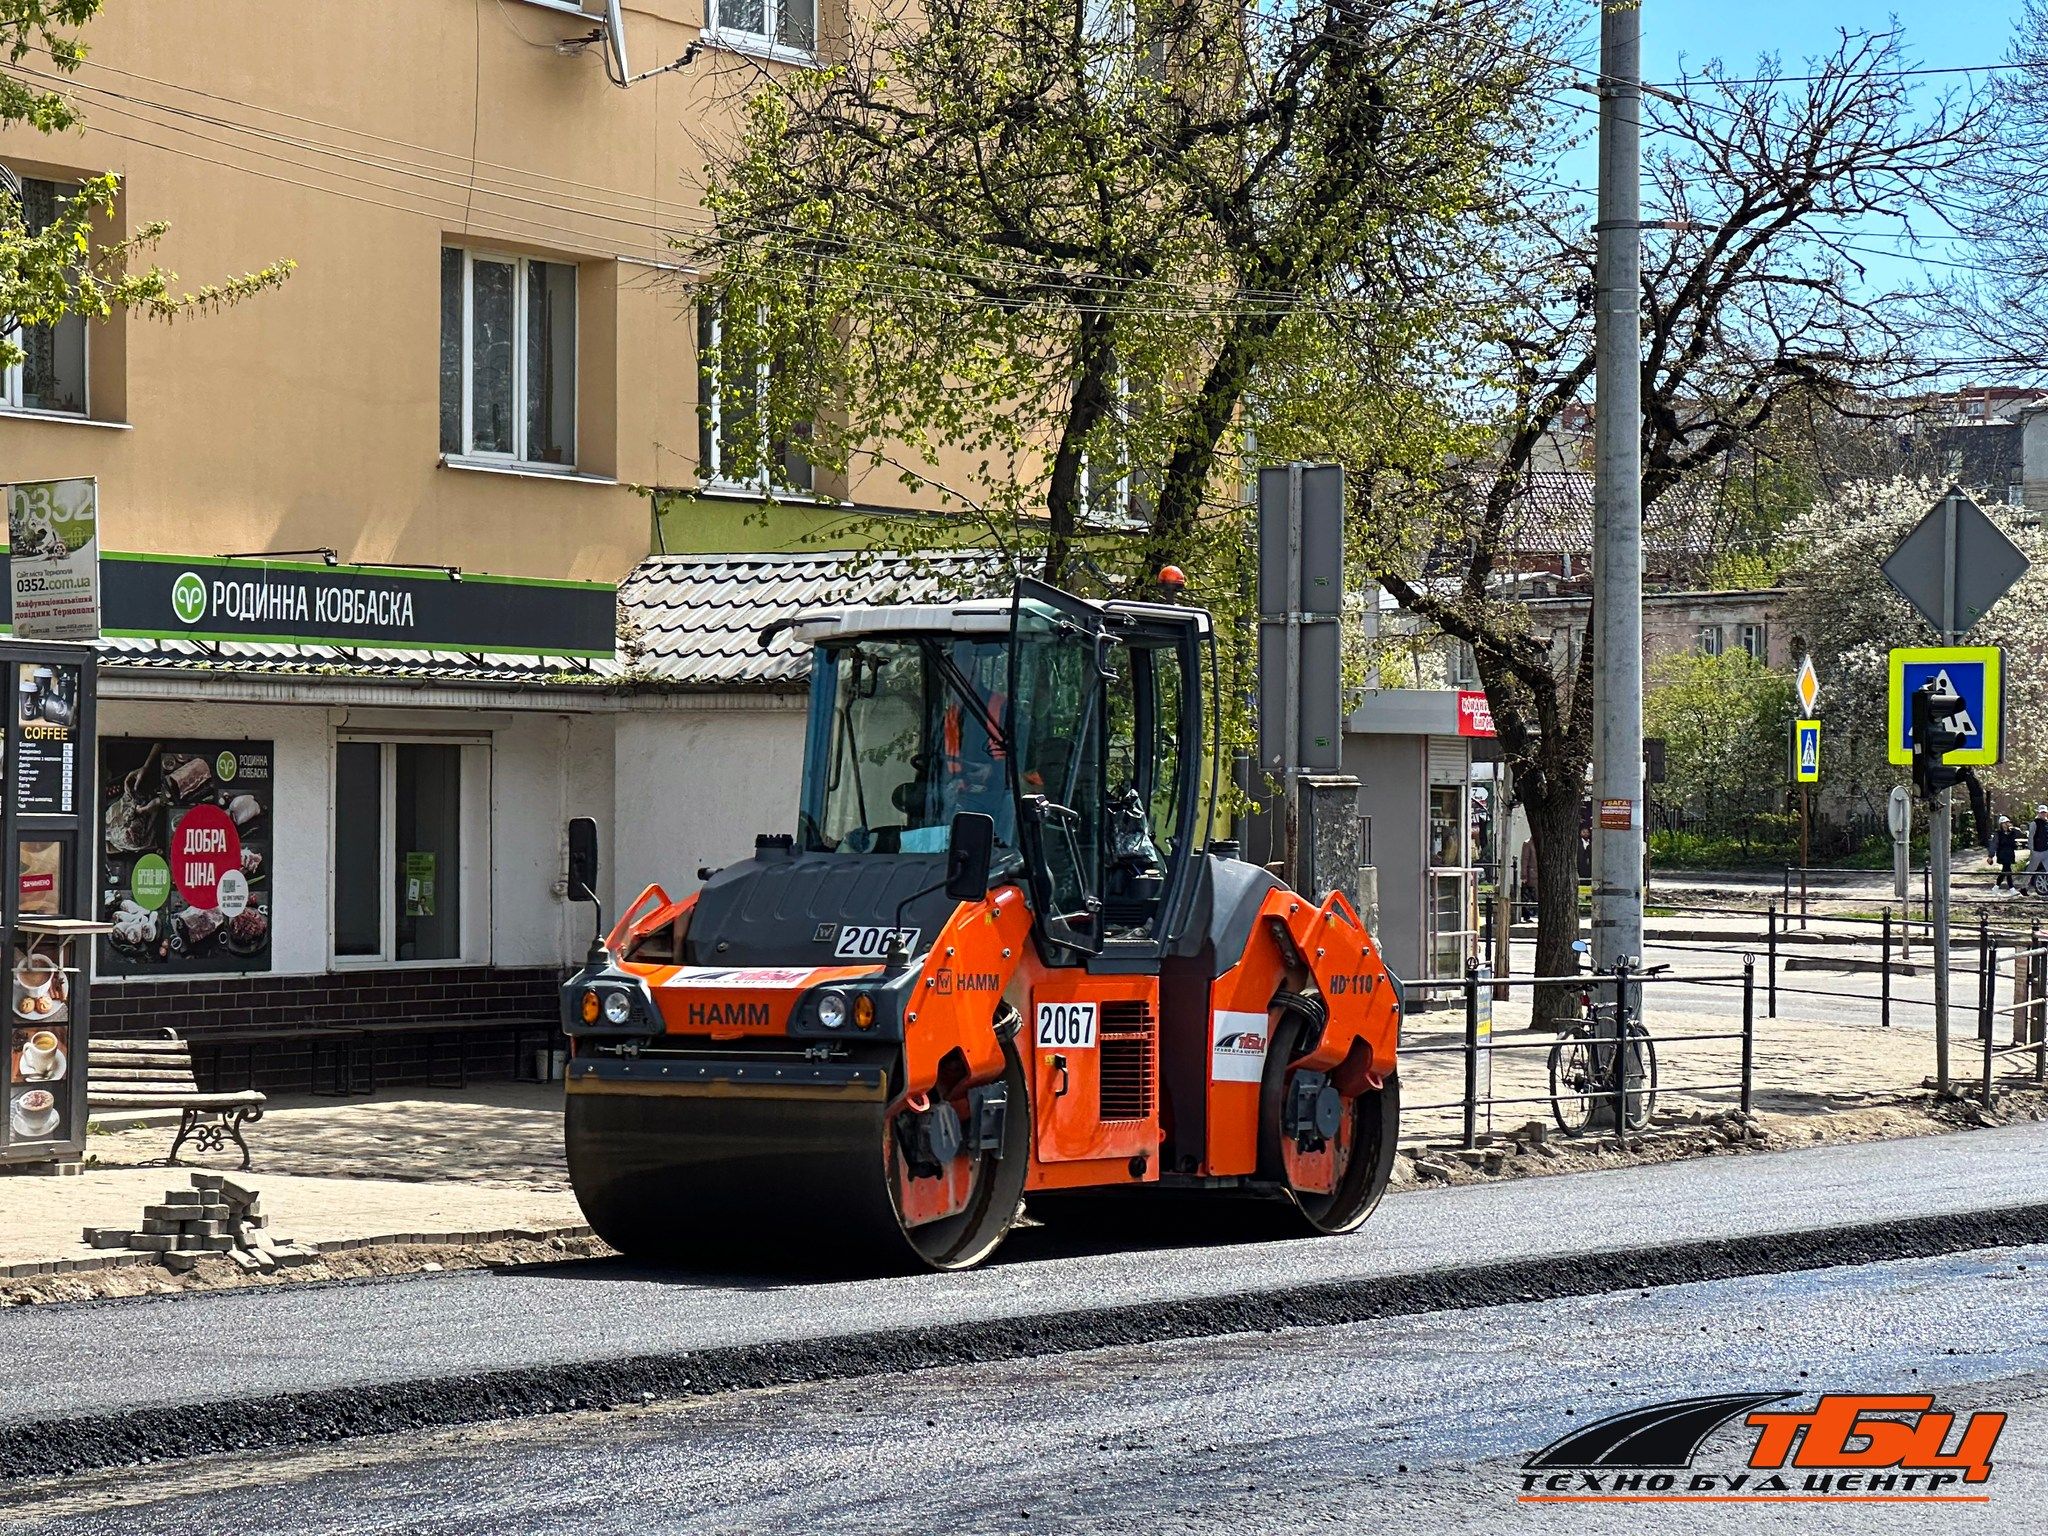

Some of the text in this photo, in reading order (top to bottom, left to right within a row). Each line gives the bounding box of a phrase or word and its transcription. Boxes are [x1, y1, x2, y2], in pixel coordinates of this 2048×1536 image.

[17, 577, 90, 592] 0352.com.ua
[213, 581, 414, 626] РОДИННА КОВБАСКА
[15, 607, 95, 619] довідник Тернополя
[24, 727, 68, 740] COFFEE
[239, 754, 268, 767] РОДИННА
[239, 767, 268, 778] КОВБАСКА
[184, 829, 226, 855] ДОБРА
[185, 863, 216, 888] ЦІНА
[957, 973, 999, 991] HAMM
[1352, 975, 1373, 994] 110
[688, 1003, 769, 1025] HAMM
[1040, 1006, 1094, 1044] 2067
